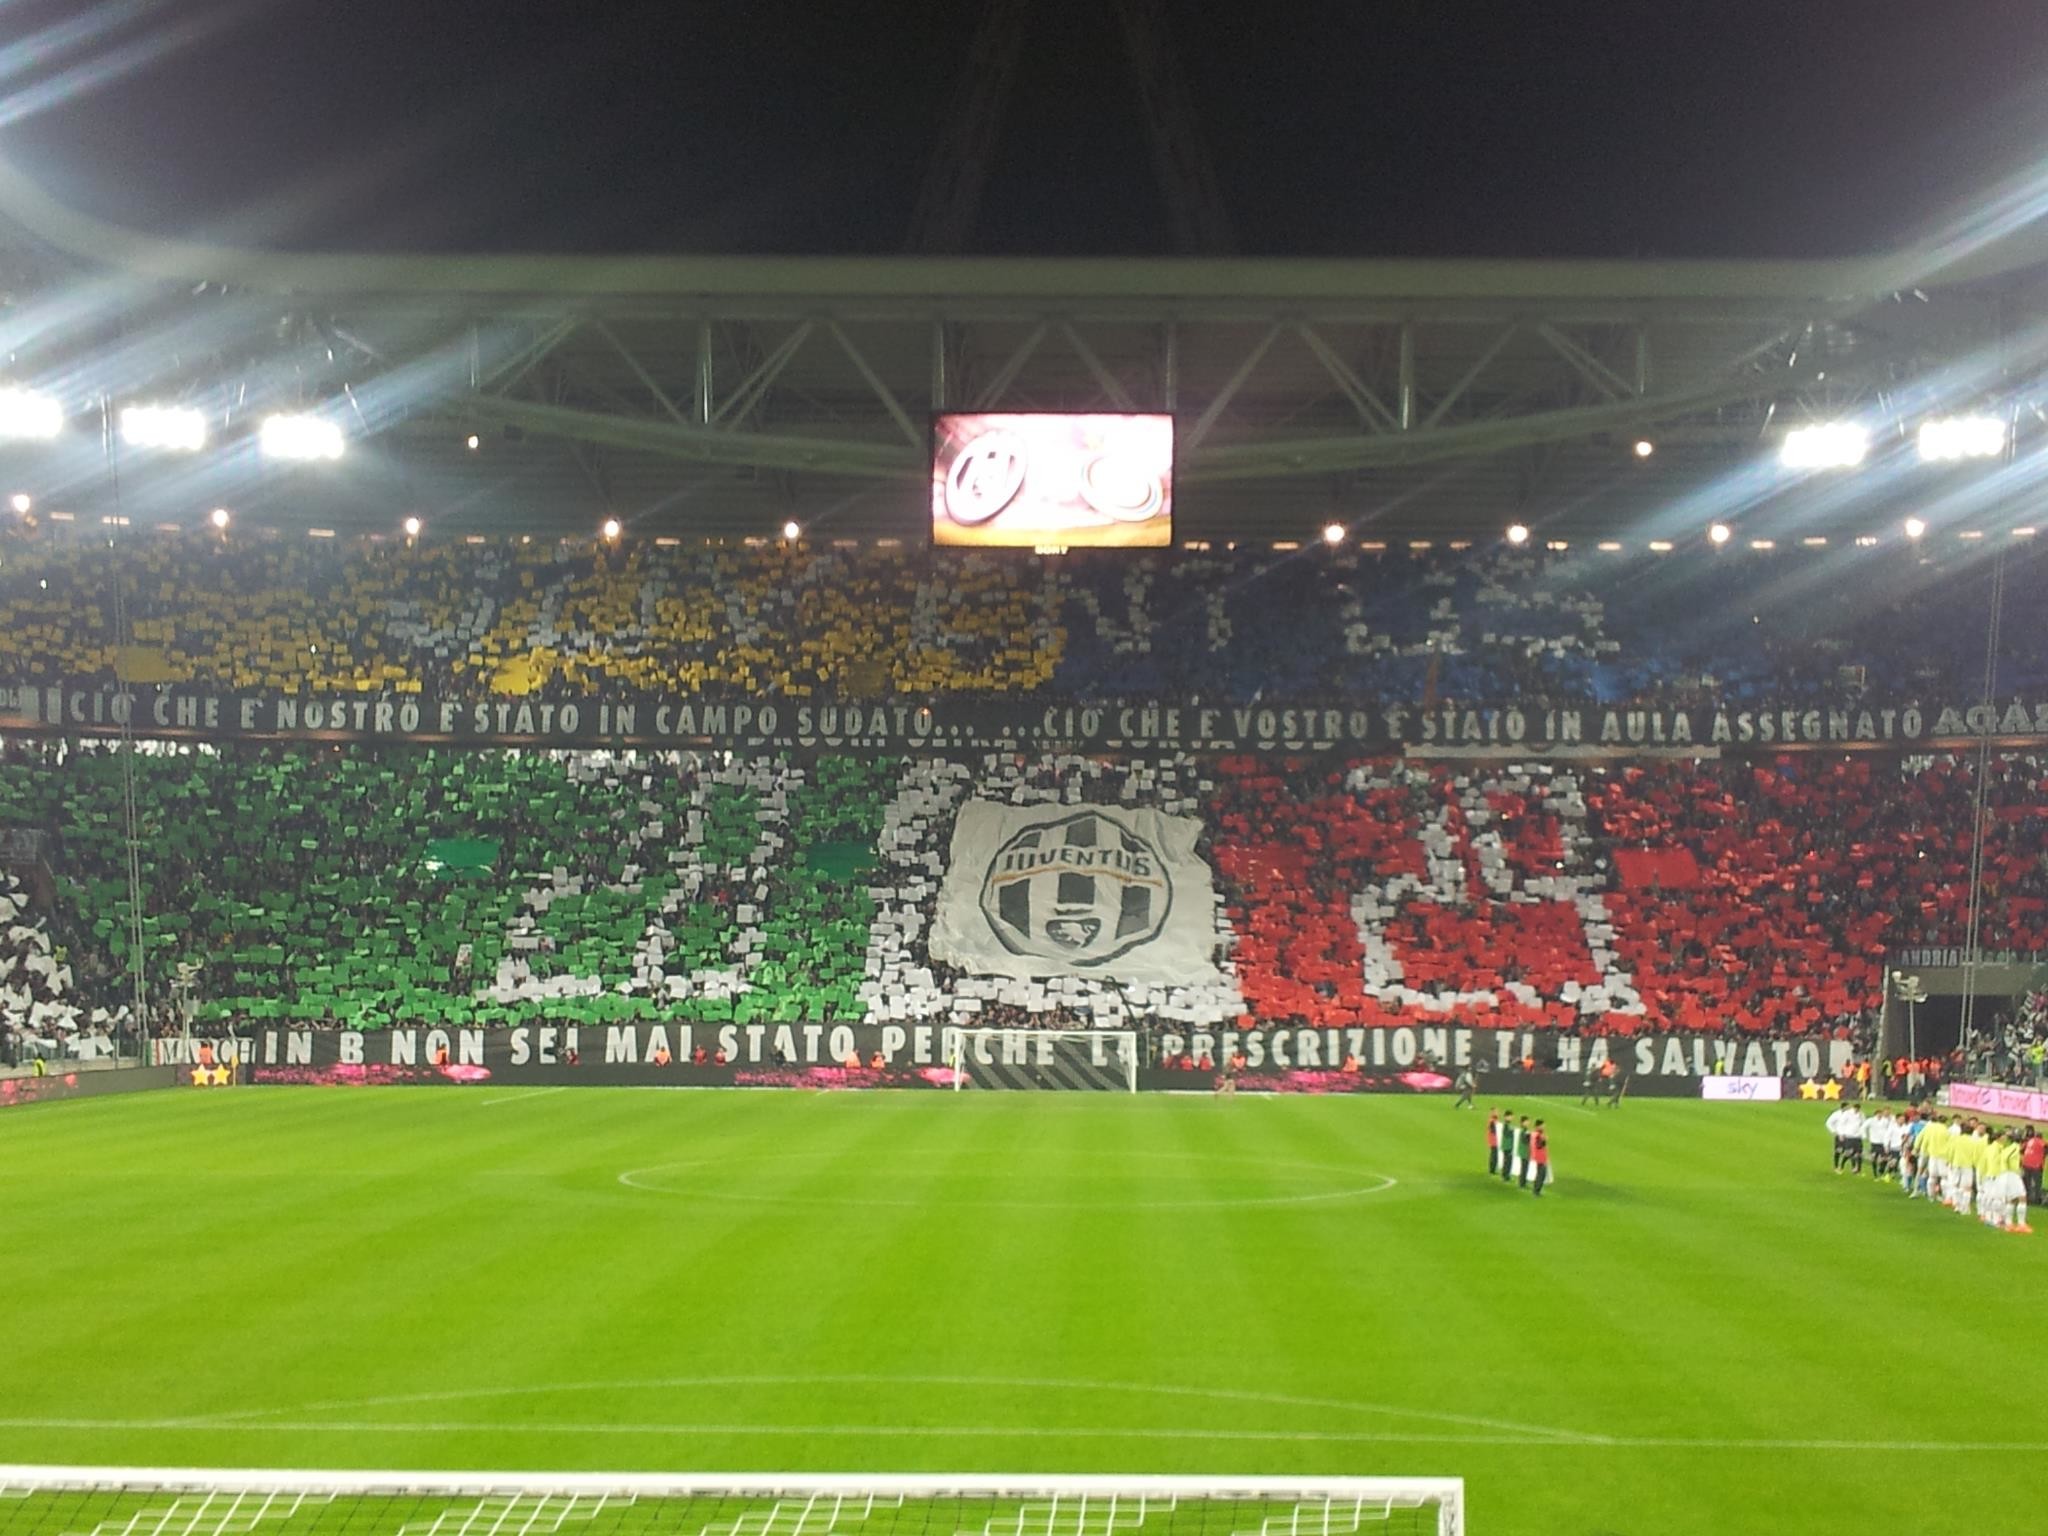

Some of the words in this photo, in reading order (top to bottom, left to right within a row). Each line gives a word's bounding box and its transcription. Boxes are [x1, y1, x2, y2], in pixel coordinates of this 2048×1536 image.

[153, 695, 219, 728] CHE
[277, 698, 420, 733] NOSTRO
[474, 703, 580, 734] STATO
[600, 704, 636, 735] IN
[655, 704, 778, 735] CAMPO
[1119, 708, 1180, 738] CHE
[1233, 708, 1368, 740] VOSTRO
[1546, 709, 1582, 740] IN
[1600, 711, 1692, 743] AULA
[1711, 708, 1923, 742] ASSEGNATO
[1003, 847, 1151, 877] JUVENTUS
[265, 1029, 312, 1065] IN
[340, 1030, 365, 1064] B
[391, 1028, 485, 1065] NON
[510, 1027, 579, 1064] SEI
[605, 1025, 693, 1063] MAI
[717, 1025, 856, 1063] STATO
[1162, 1028, 1472, 1067] PRESCRIZIONE
[1496, 1030, 1534, 1069] TI
[1557, 1037, 1609, 1073] HA
[1727, 1077, 1759, 1100] sky
